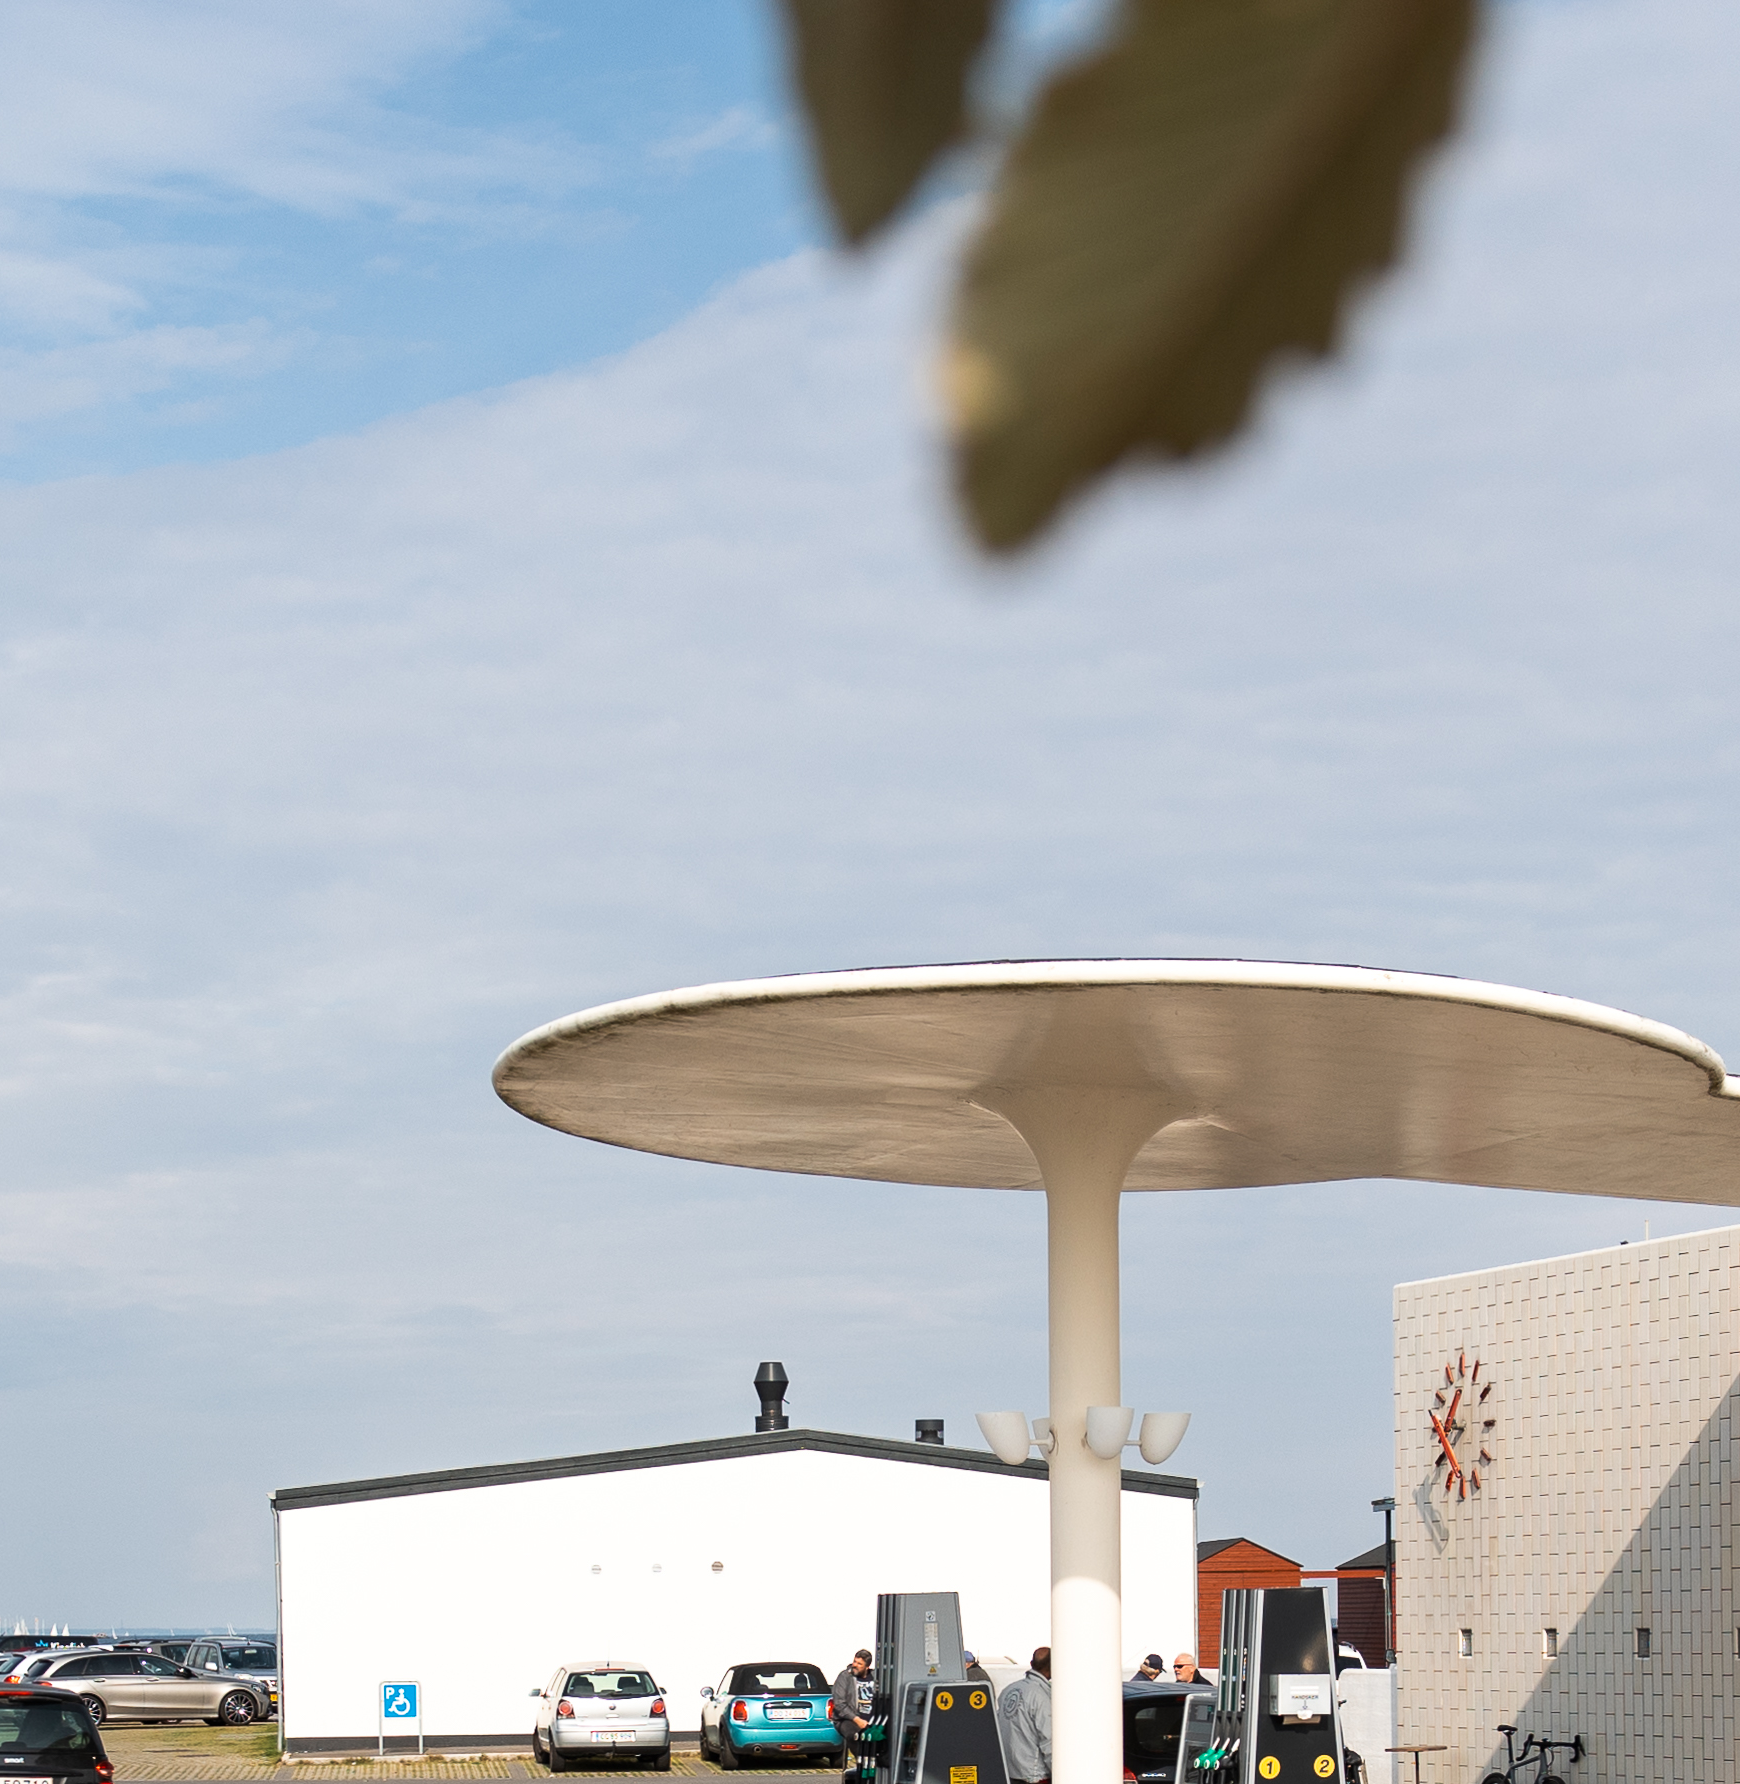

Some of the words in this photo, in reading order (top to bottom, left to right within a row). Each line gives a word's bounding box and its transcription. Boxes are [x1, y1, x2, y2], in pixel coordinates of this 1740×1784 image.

[385, 1686, 395, 1700] P
[973, 1693, 983, 1706] 3
[939, 1694, 949, 1707] 4
[1267, 1761, 1273, 1775] 1
[1319, 1759, 1330, 1773] 2
